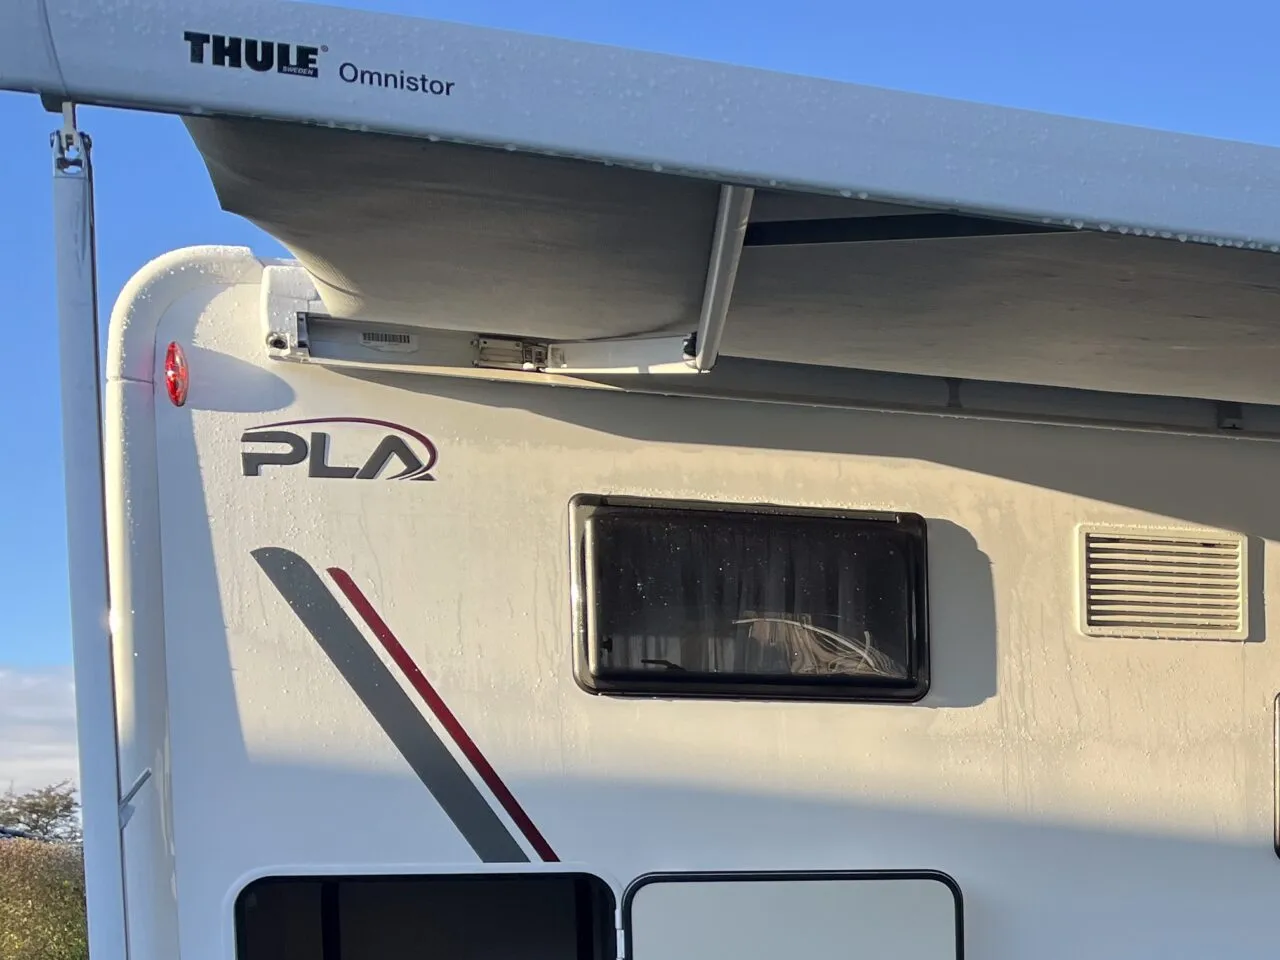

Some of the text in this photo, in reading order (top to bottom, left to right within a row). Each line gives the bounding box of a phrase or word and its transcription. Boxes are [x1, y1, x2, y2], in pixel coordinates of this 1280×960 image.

[184, 31, 318, 77] THULE
[282, 65, 314, 76] SWEDEN
[339, 62, 455, 96] Omnistor
[241, 430, 436, 481] PLA
